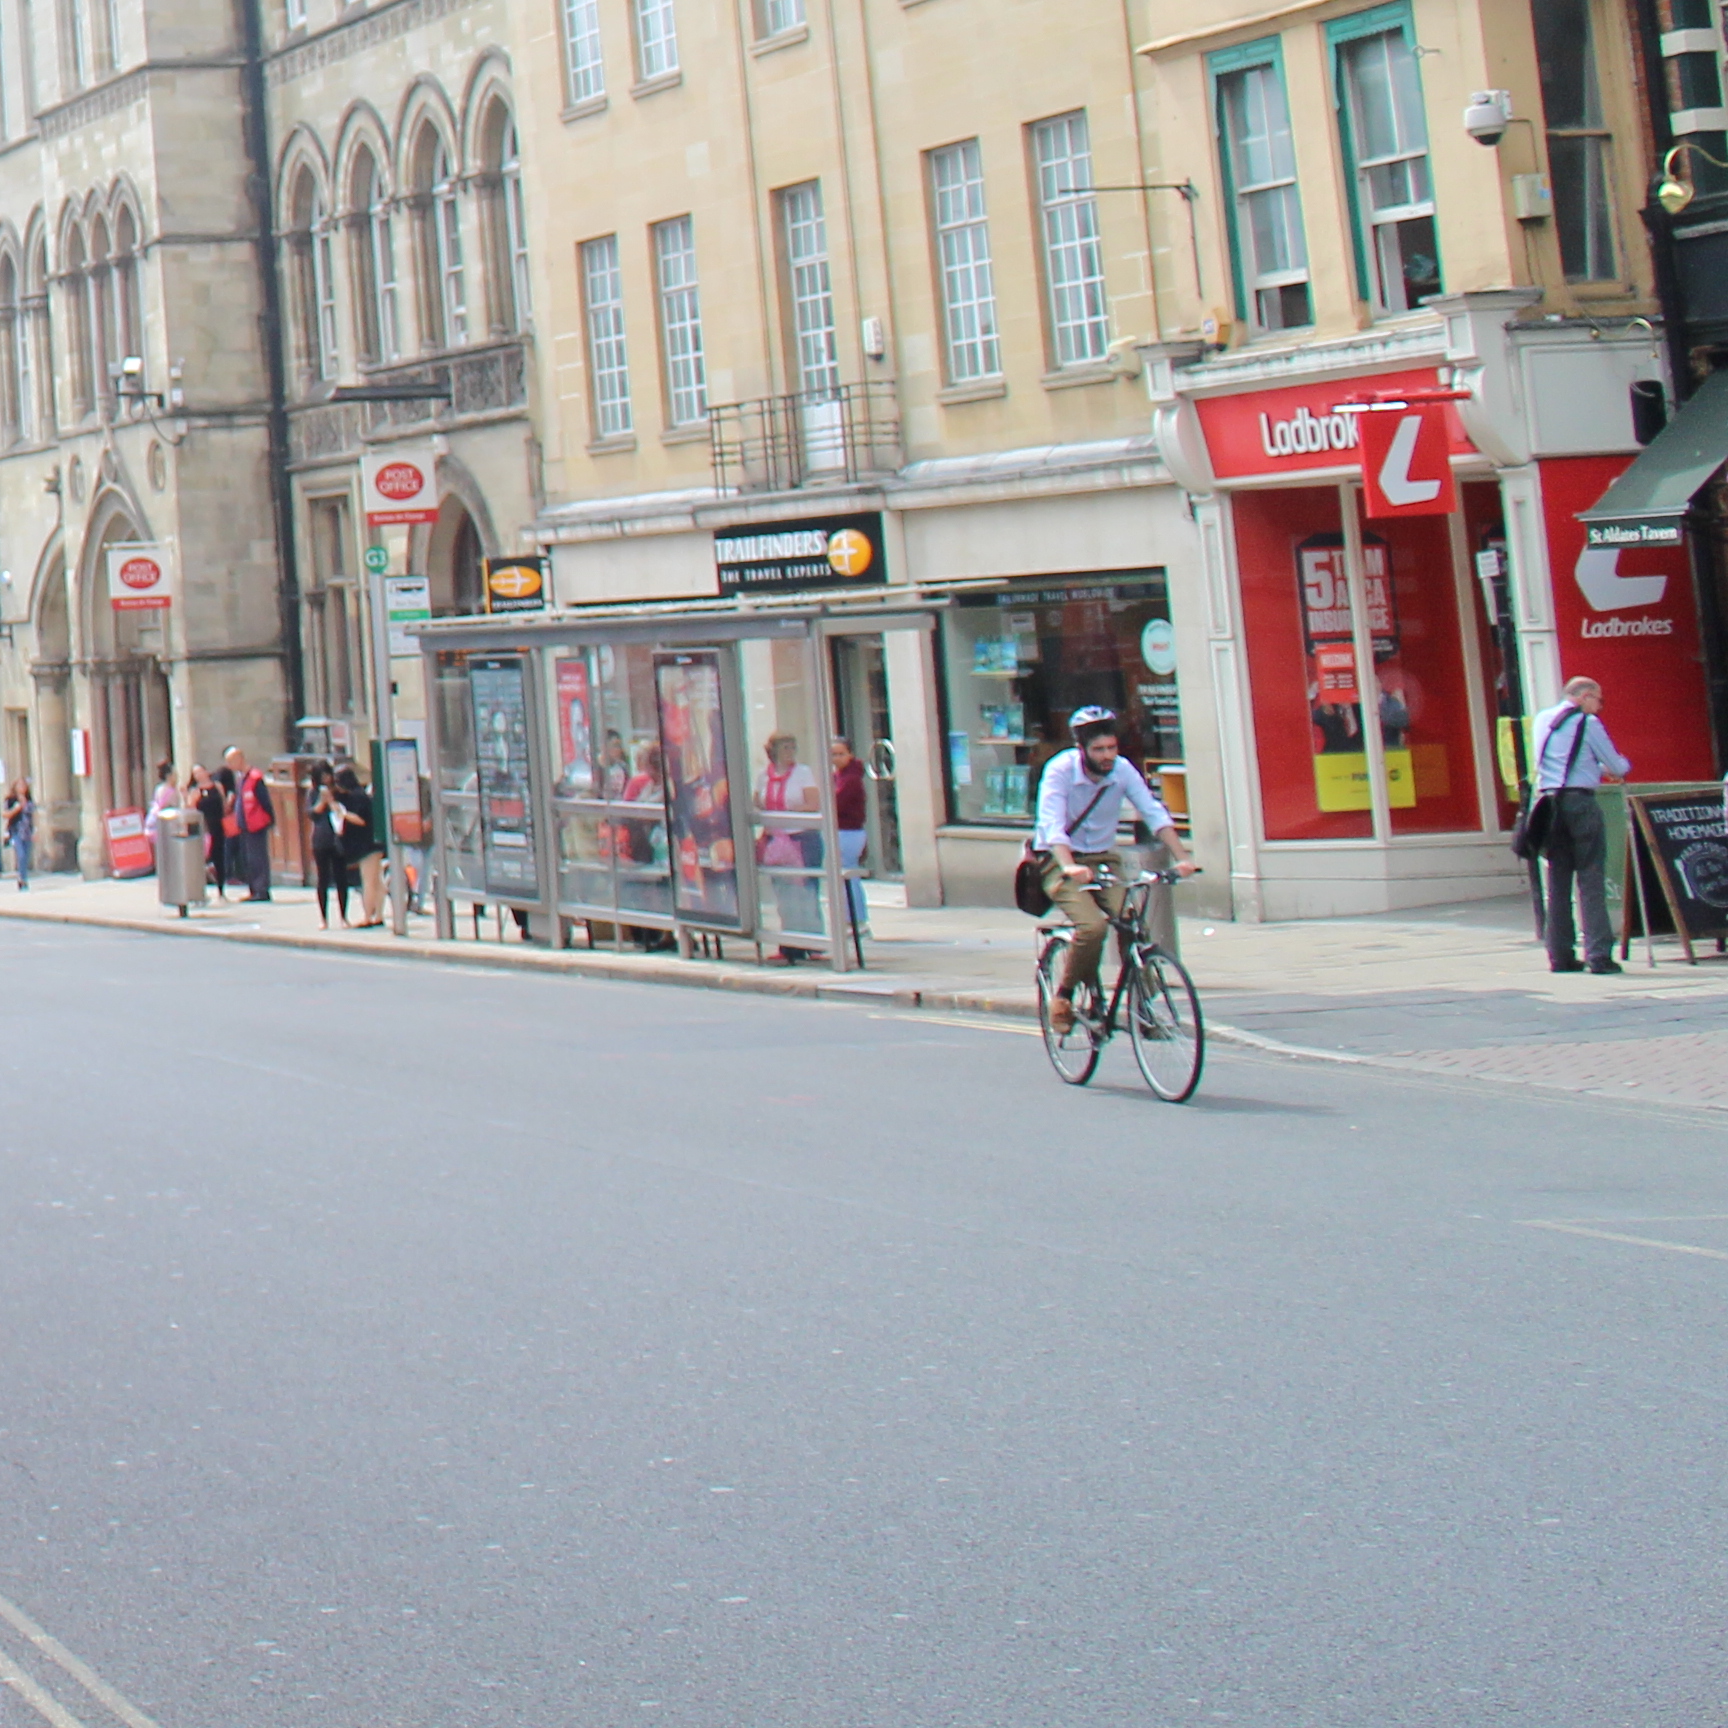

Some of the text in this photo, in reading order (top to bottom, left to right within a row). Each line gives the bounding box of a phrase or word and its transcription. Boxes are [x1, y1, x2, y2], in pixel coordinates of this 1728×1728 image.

[1258, 406, 1360, 457] Ladbrok
[385, 469, 414, 480] POST
[380, 478, 420, 492] OFFICE
[1640, 523, 1678, 540] Tavern
[715, 529, 827, 564] TRAILFINDERS
[365, 549, 386, 567] G3
[128, 563, 152, 572] POST
[720, 563, 832, 583] THE TRAVEL EXPERTS
[123, 573, 157, 584] OFFICE
[1302, 548, 1384, 609] 5 TM
[1581, 616, 1672, 638] Ladbrokes
